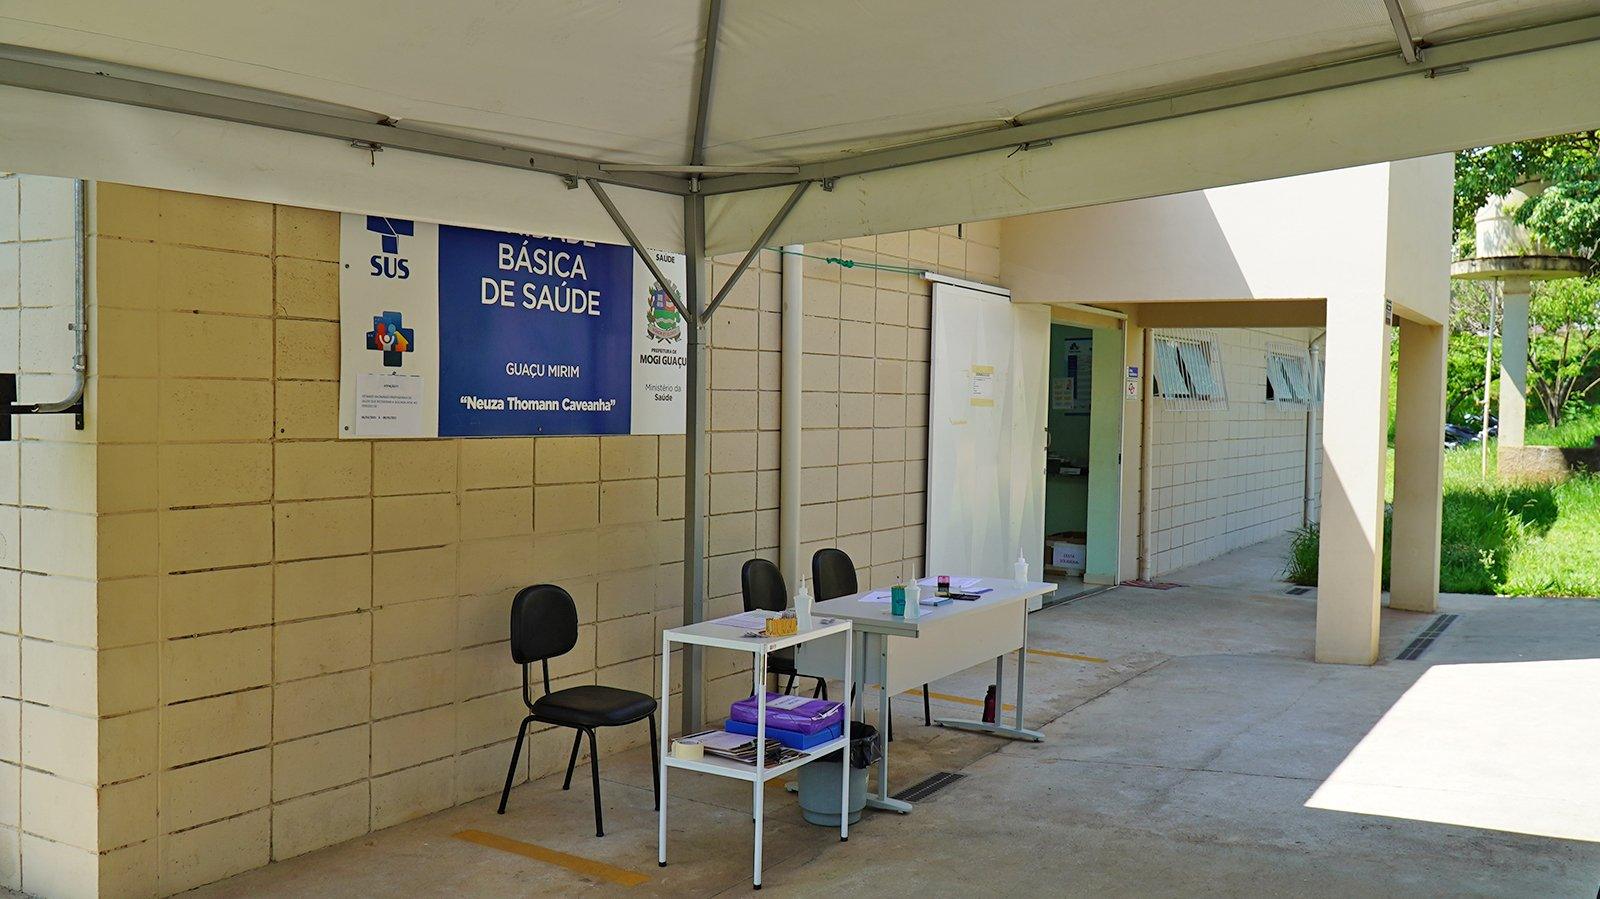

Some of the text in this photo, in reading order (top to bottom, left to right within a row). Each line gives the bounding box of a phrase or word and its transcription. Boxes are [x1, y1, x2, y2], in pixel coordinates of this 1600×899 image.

[498, 240, 588, 281] BÁSICA
[655, 252, 675, 264] SAÚDE
[370, 255, 410, 280] SUS
[481, 277, 601, 316] DE SAÚDE
[639, 354, 688, 369] MOGI GUAÇU
[505, 362, 580, 378] GUAÇU MIRIM
[645, 383, 682, 392] Ministério da
[459, 395, 617, 412] “Neuza Thomann Caveanha”
[654, 392, 673, 402] Saúde
